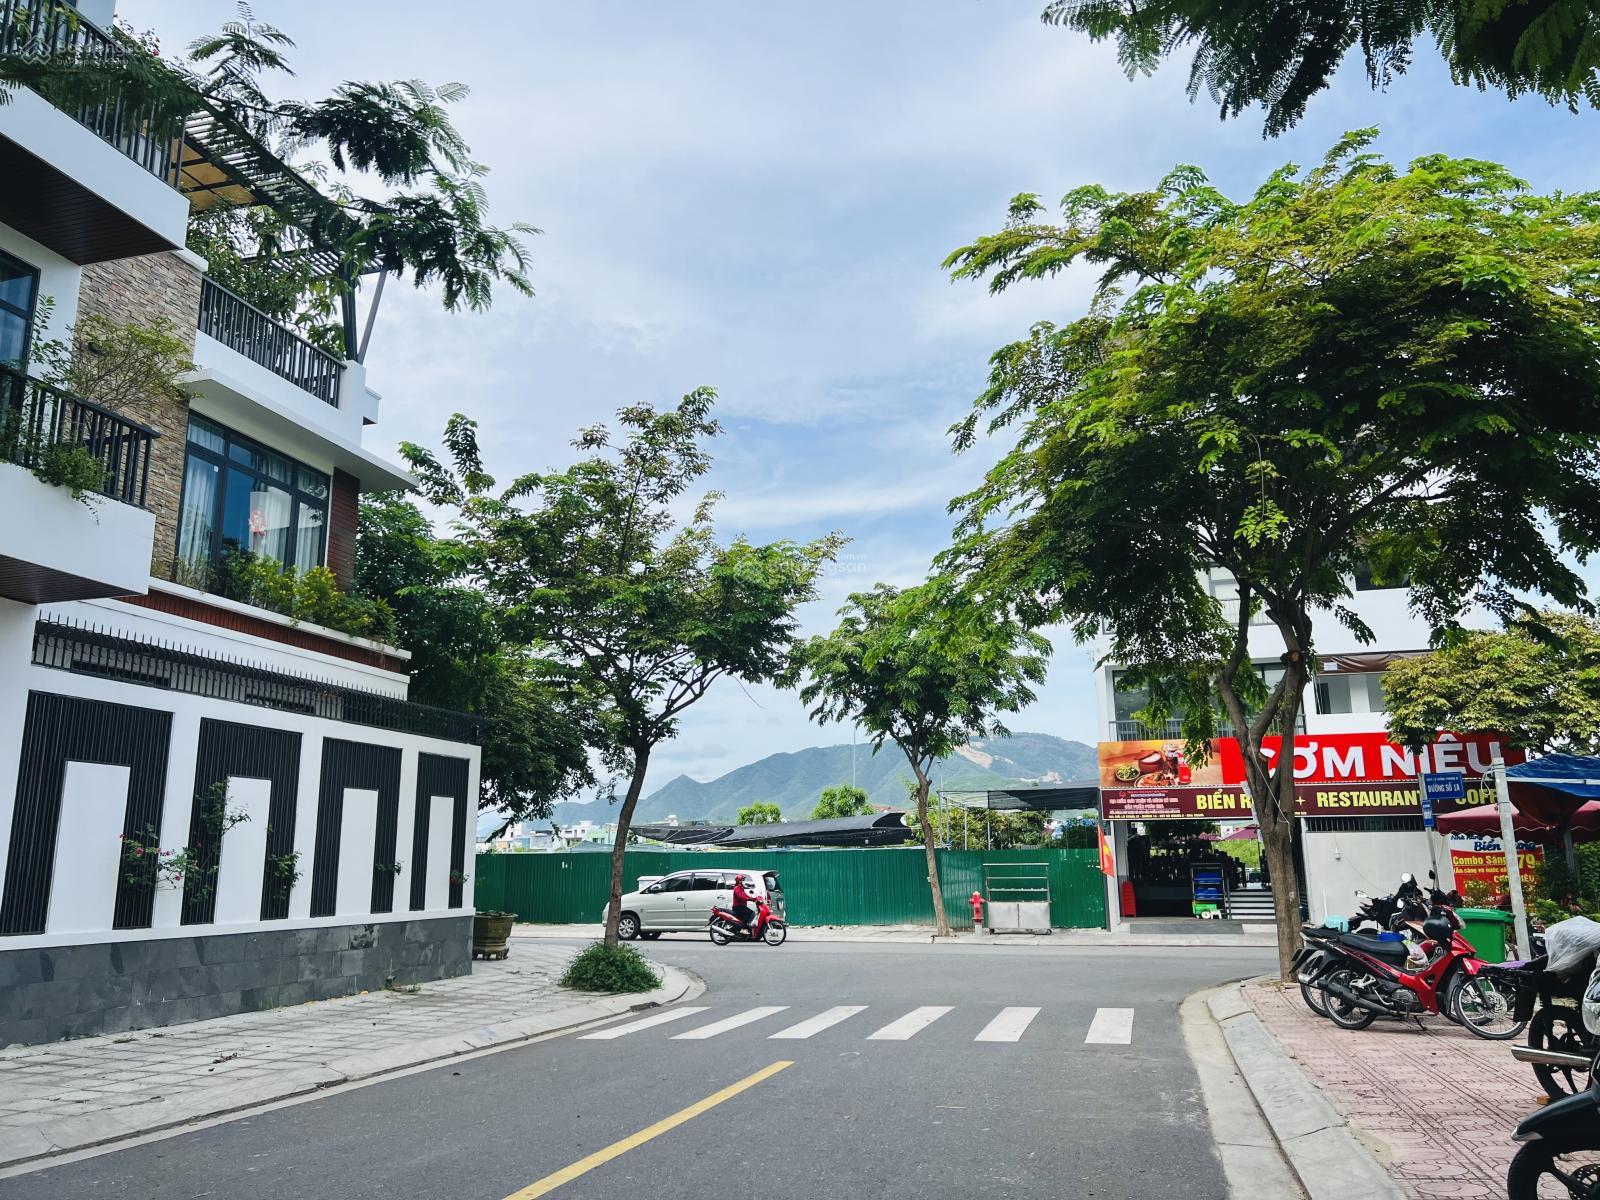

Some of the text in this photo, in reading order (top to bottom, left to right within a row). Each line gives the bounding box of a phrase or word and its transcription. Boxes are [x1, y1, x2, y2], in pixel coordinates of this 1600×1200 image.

[1380, 734, 1500, 775] NIÊU
[1445, 782, 1452, 792] SỐ
[1196, 788, 1235, 809] BIỂN
[1474, 838, 1501, 851] Biển
[1453, 855, 1484, 865] Combo
[1518, 853, 1536, 869] 79
[1520, 873, 1535, 883] IÊU
